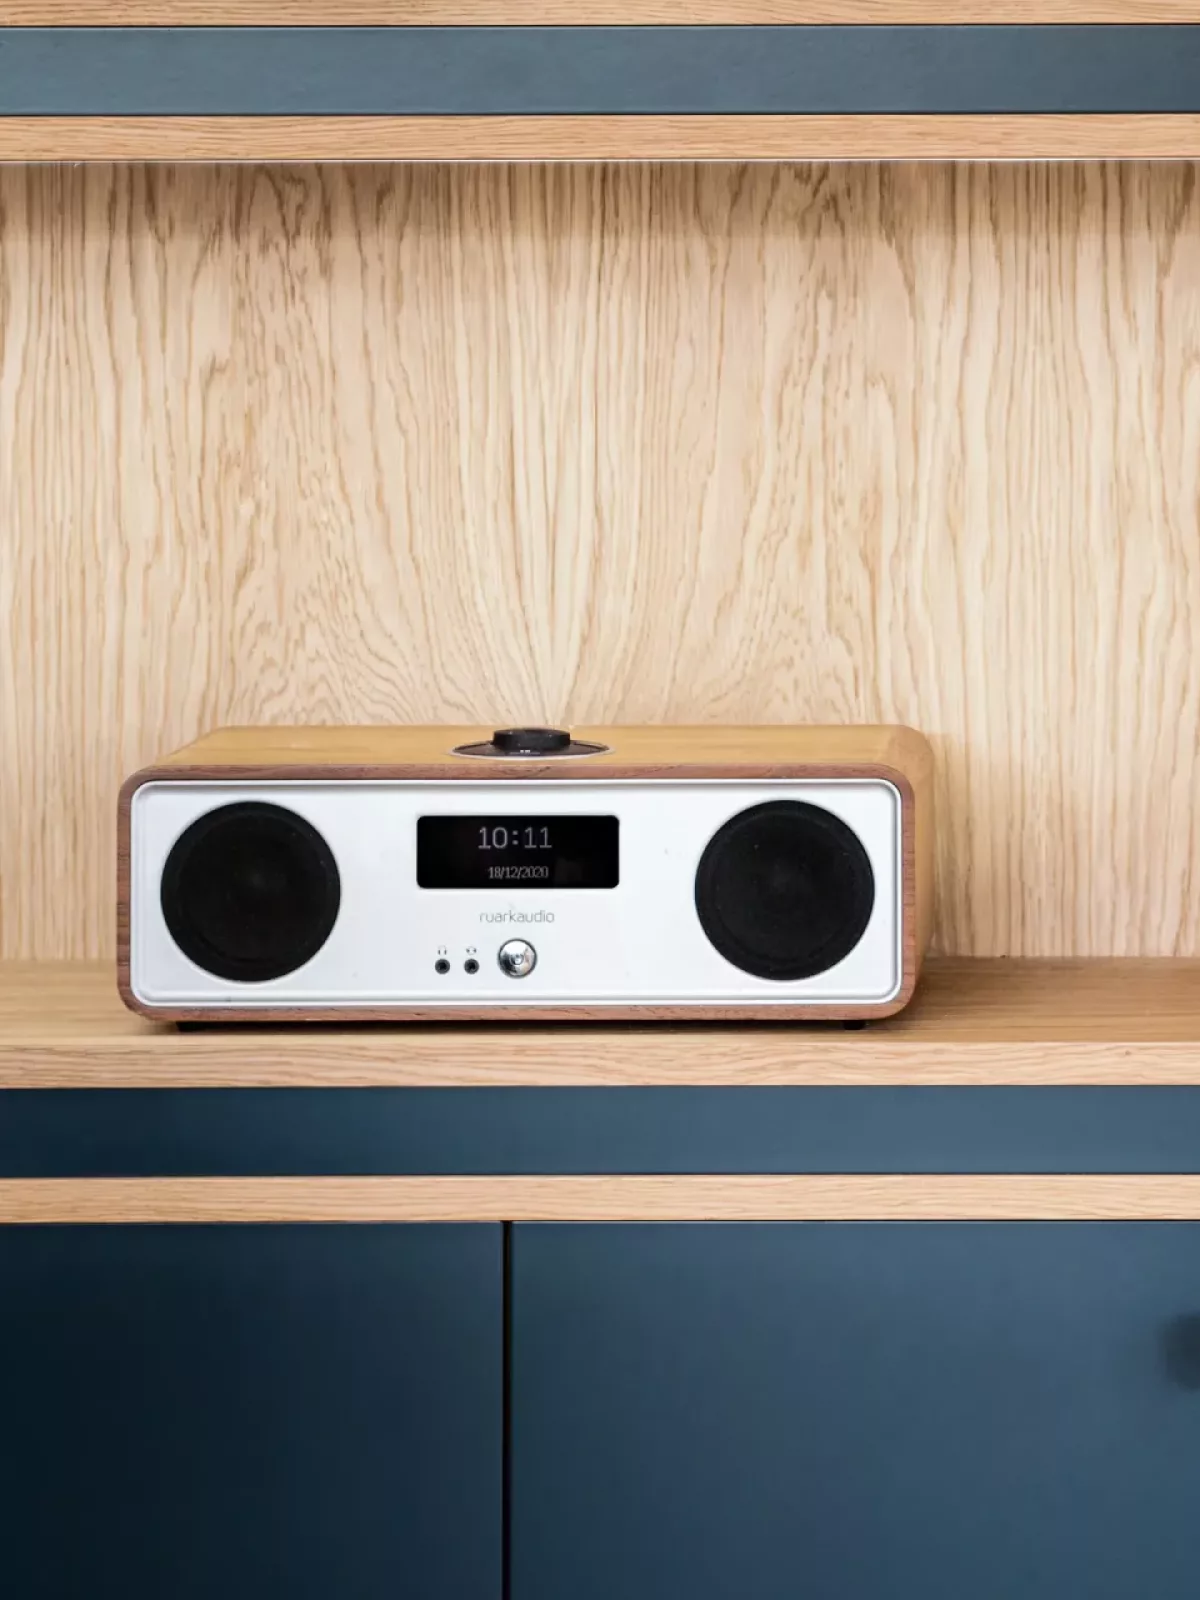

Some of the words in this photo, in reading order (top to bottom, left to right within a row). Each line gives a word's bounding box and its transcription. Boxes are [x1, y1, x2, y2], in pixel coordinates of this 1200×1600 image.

[478, 826, 552, 849] 10:11
[487, 865, 549, 880] 18/12/2020
[479, 909, 555, 924] ruarkaudio
